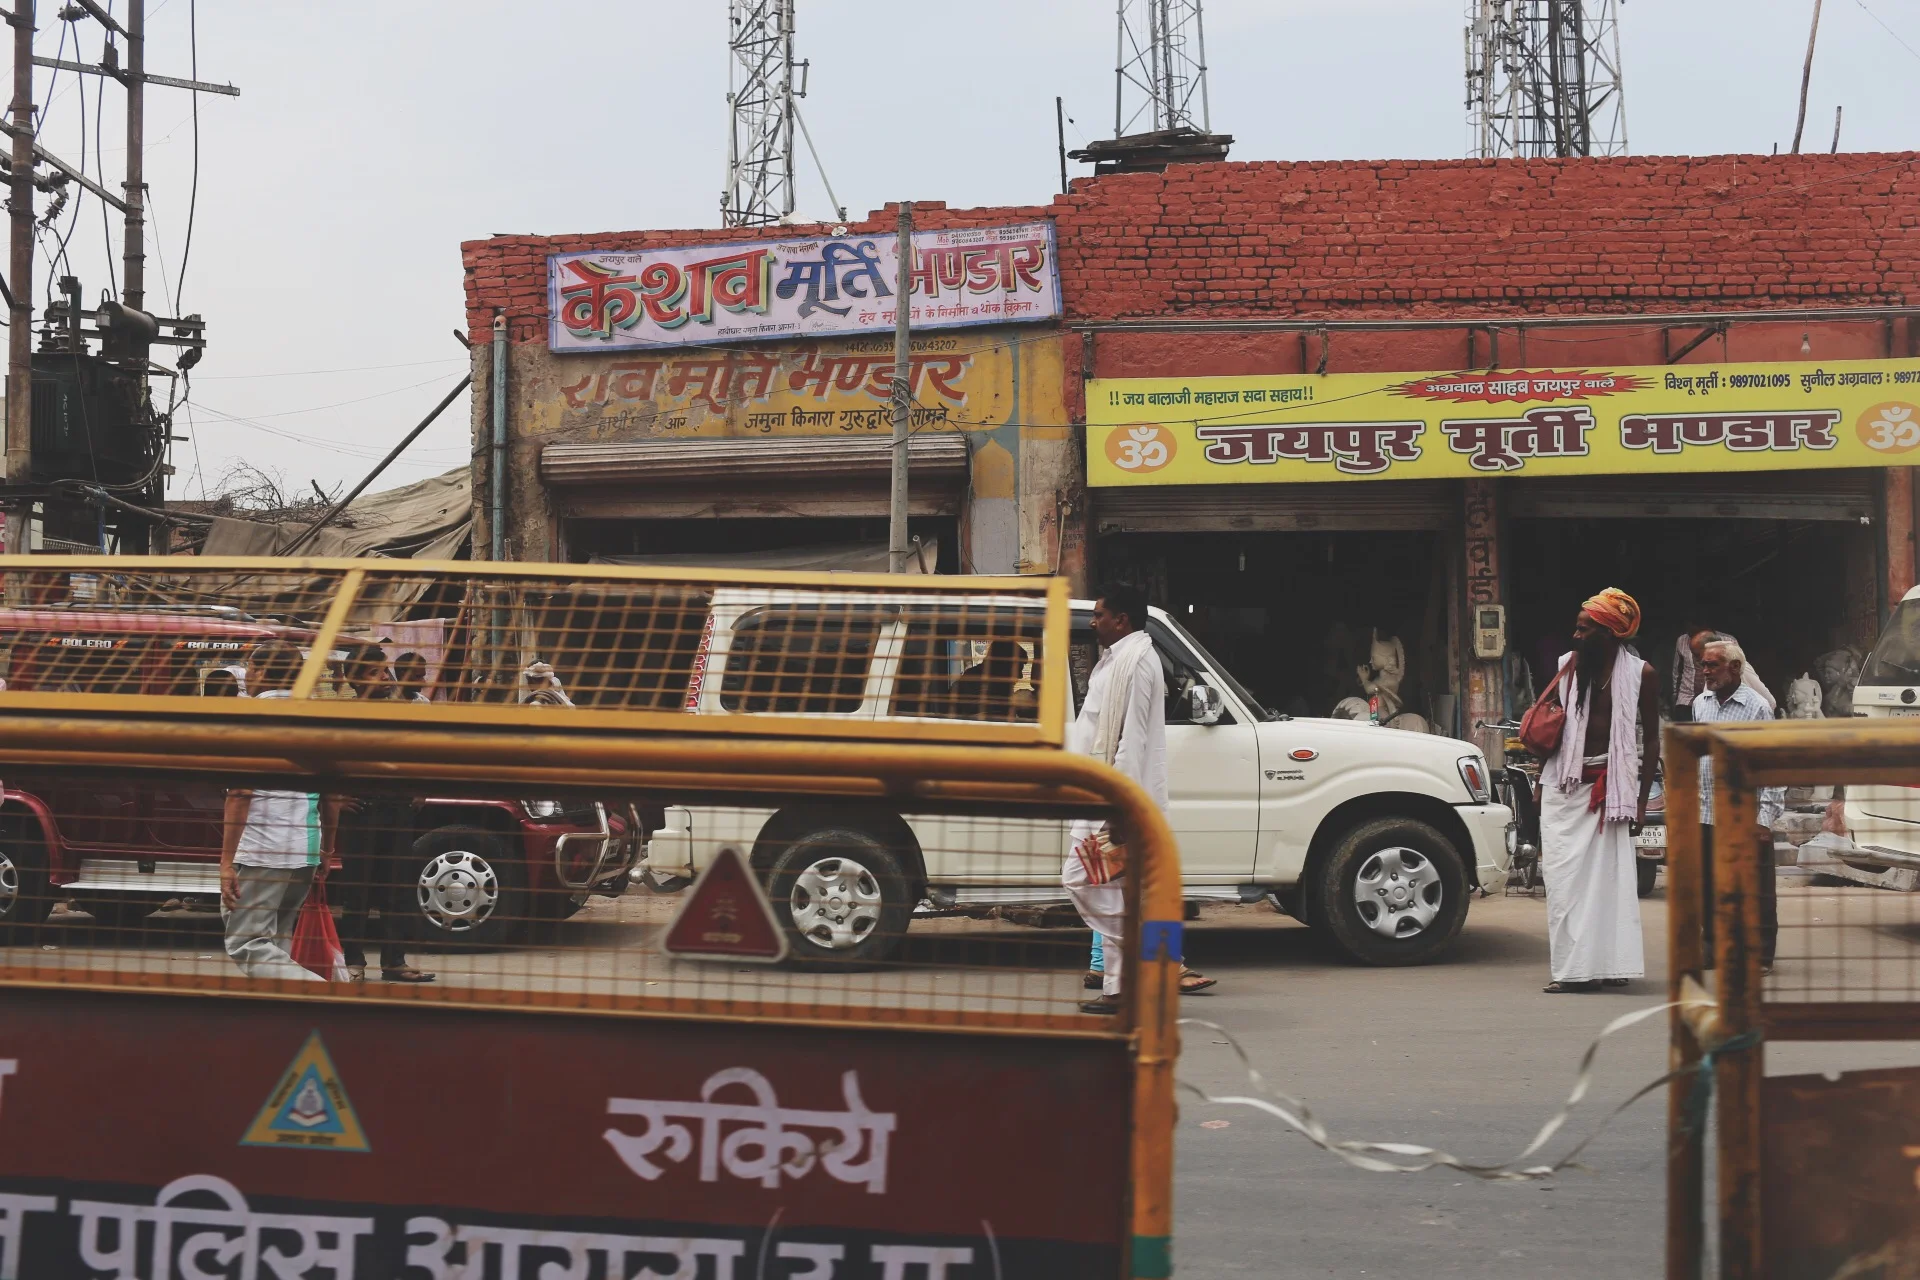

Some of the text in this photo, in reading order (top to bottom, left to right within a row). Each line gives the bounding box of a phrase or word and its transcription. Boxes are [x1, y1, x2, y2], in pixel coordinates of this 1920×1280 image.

[599, 253, 643, 265] जयपुर वाले
[560, 249, 776, 340] केशव
[776, 241, 895, 319] मूर्ति
[859, 309, 877, 325] देव
[925, 305, 935, 318] के
[981, 301, 1000, 313] थोक
[1426, 377, 1615, 396] अग्रवाल साहब जयपुर वाले
[1664, 372, 1693, 395] विश्नू
[1695, 371, 1719, 395] मूर्ती
[1729, 373, 1791, 390] 9897021095
[1800, 368, 1835, 393] सुनील
[1838, 371, 1884, 388] अग्रवाल
[1123, 391, 1145, 406] जय
[1147, 387, 1191, 406] बालाजी
[1194, 390, 1240, 406] महाराज
[1243, 389, 1266, 403] सदा
[744, 412, 787, 432] जमुना
[791, 405, 835, 427] किनारा
[1196, 405, 1842, 474] जयपुर मूर्ती भण्डार
[61, 637, 112, 649] BOLERO
[187, 640, 239, 651] BOLERO
[602, 1066, 896, 1194] रुकिये
